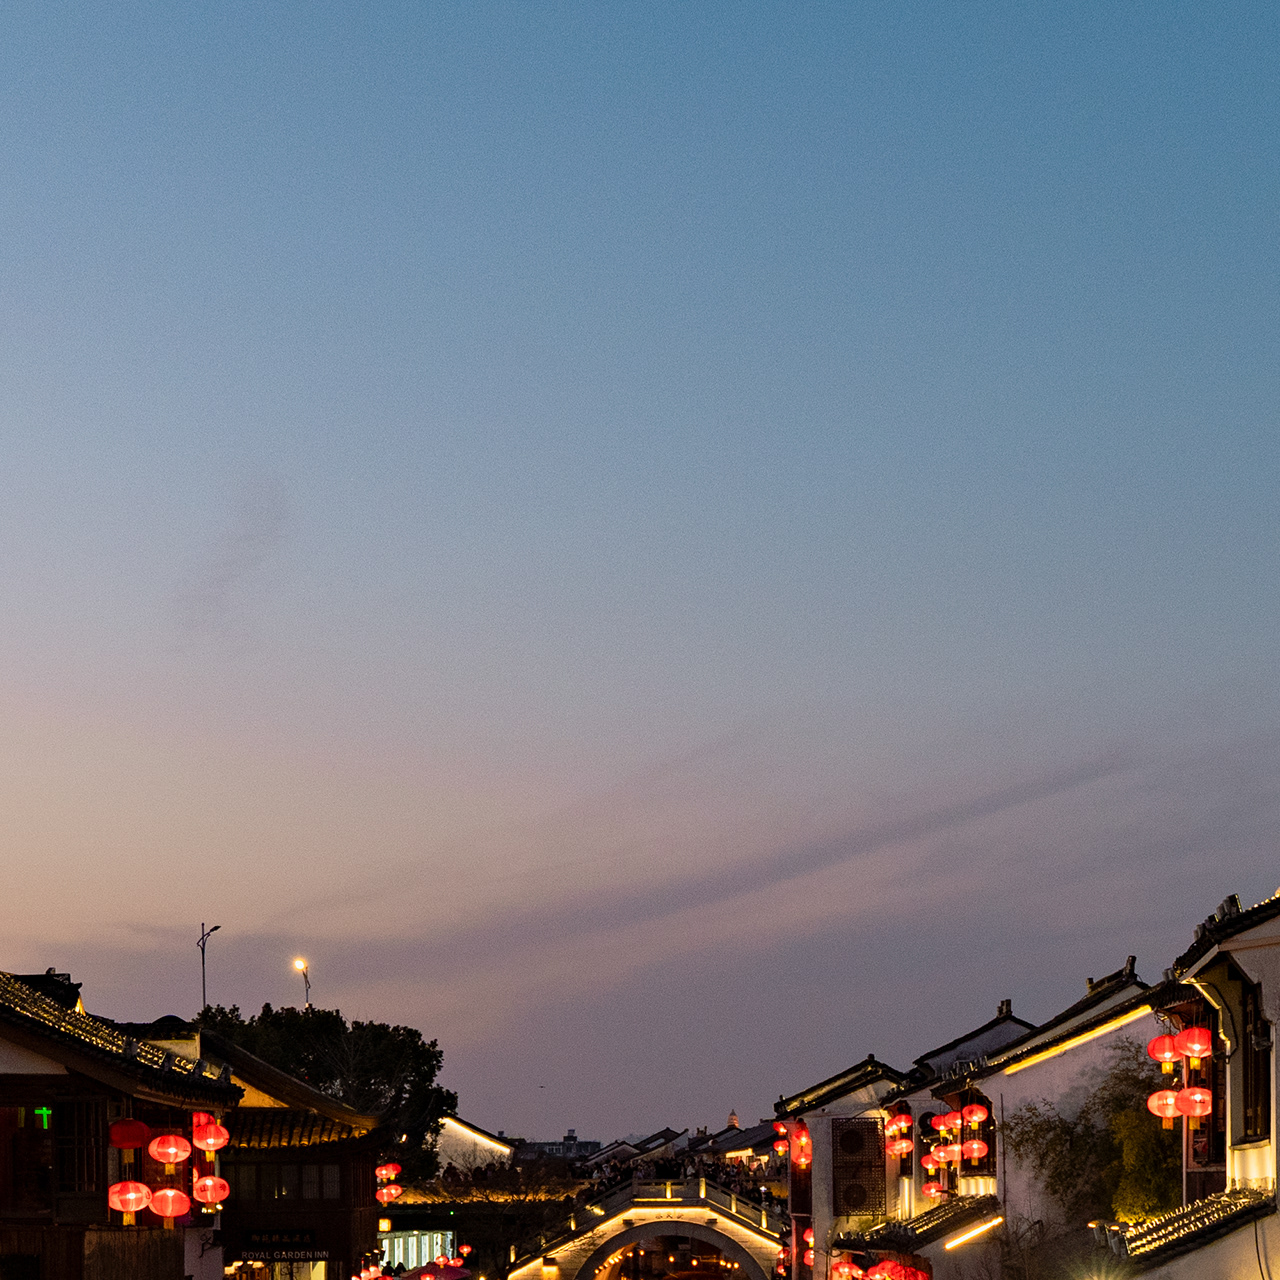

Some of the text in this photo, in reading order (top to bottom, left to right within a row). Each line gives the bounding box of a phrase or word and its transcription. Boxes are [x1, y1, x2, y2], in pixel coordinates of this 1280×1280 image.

[241, 1250, 329, 1259] ROYAL GARDEN INN
